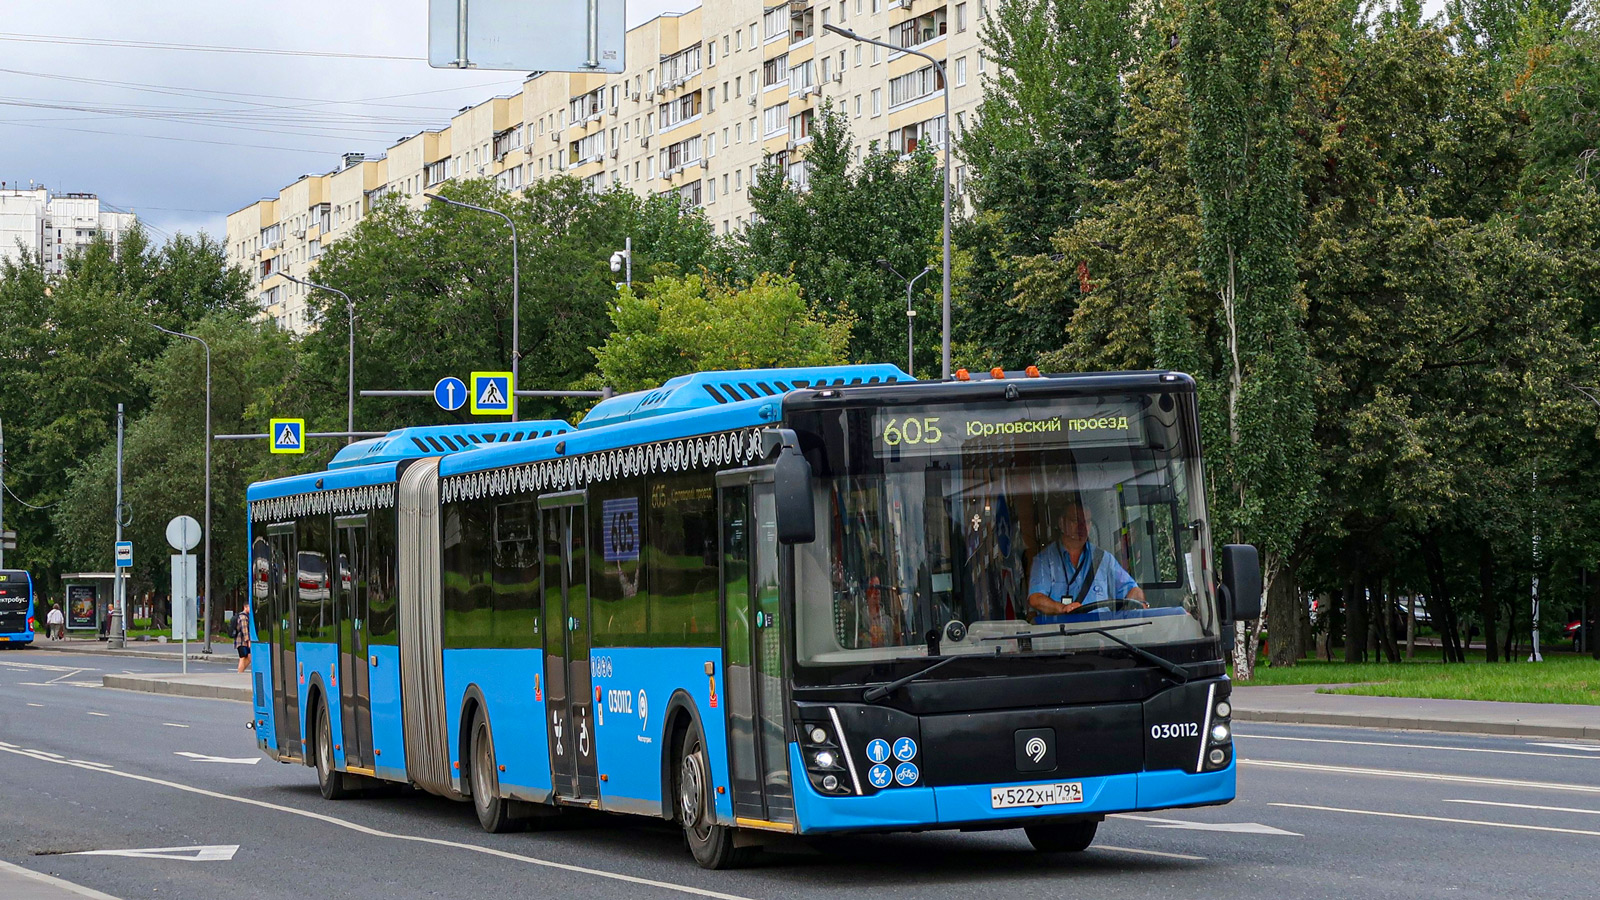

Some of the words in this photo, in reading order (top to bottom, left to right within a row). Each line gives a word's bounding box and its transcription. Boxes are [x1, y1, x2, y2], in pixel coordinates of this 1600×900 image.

[884, 417, 942, 446] 605
[966, 417, 1061, 437] Юрловский
[1068, 416, 1129, 432] проезд
[611, 511, 634, 553] 605
[608, 689, 633, 714] 030112
[1151, 722, 1199, 739] 030112
[1056, 784, 1079, 797] 799
